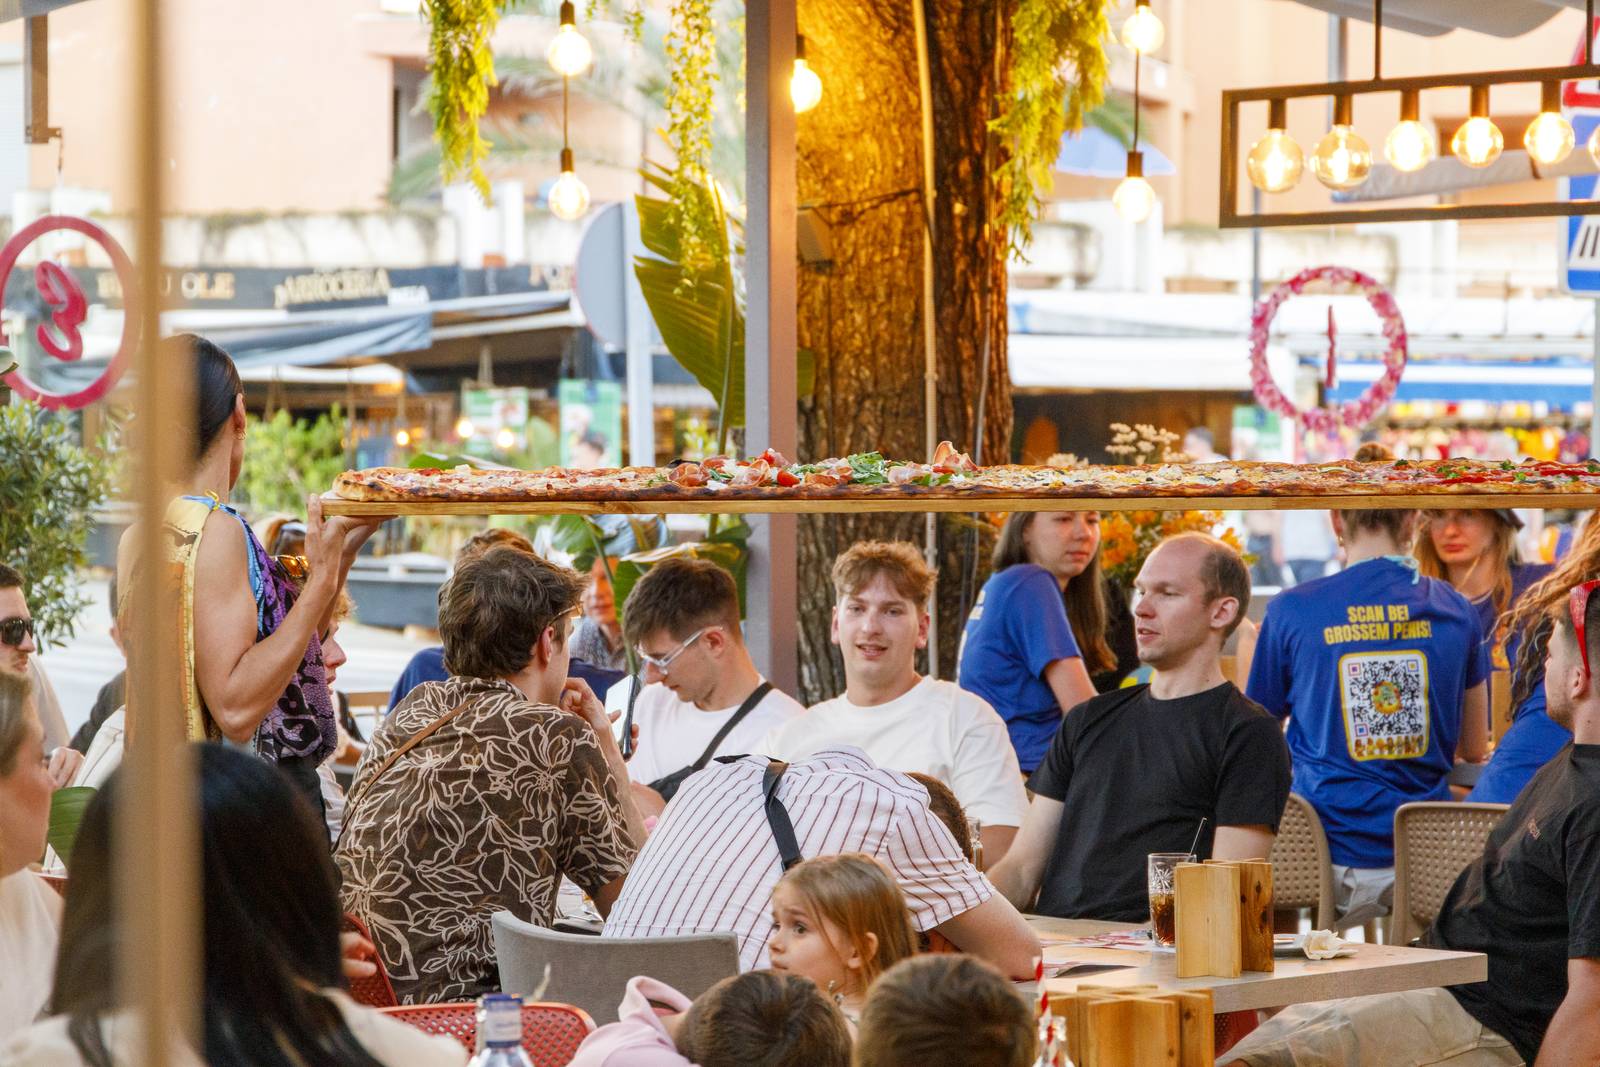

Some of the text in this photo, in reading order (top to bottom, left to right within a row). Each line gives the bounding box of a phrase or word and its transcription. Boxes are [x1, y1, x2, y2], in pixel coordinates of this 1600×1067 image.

[1347, 605, 1409, 623] SCAN BEI
[1324, 620, 1432, 645] GROSSEM PENIS!
